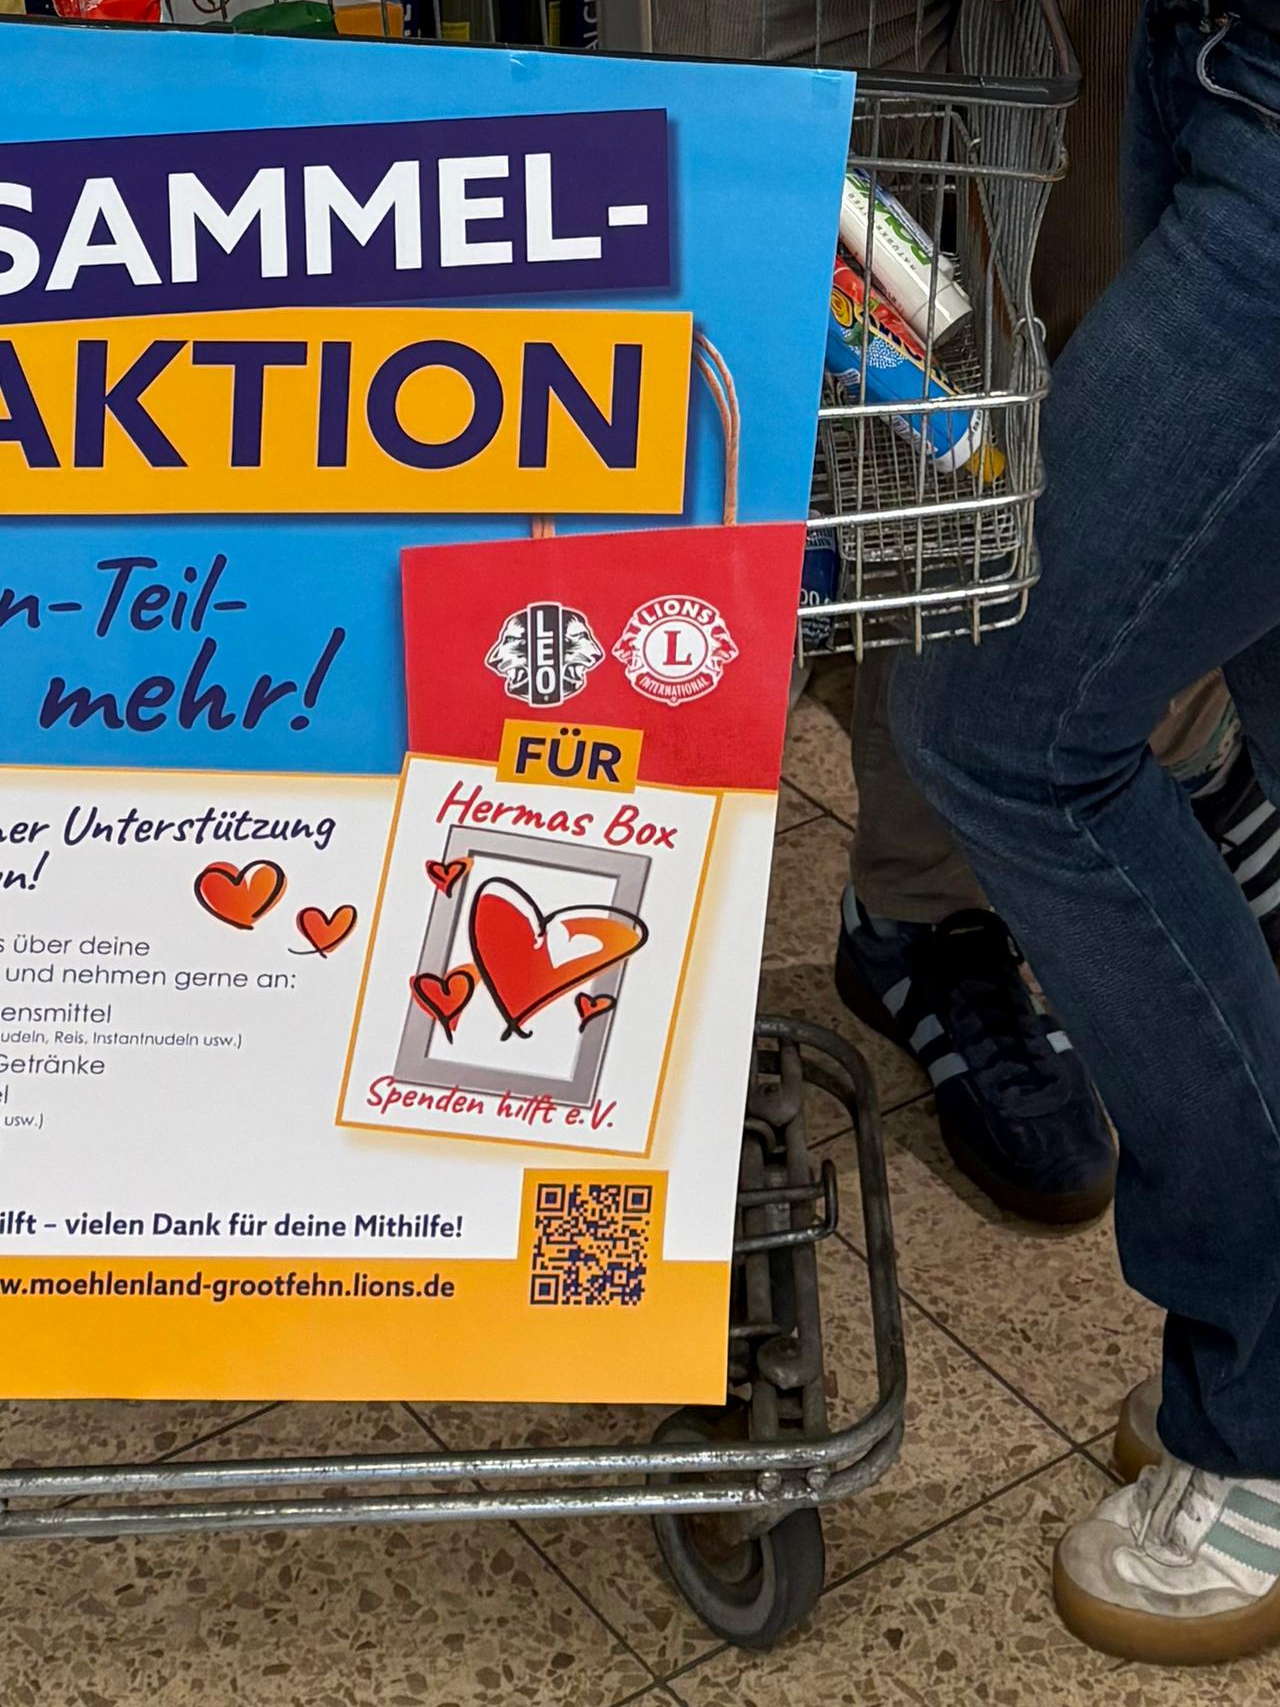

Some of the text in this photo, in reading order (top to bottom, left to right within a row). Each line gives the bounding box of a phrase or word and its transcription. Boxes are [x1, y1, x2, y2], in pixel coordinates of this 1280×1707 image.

[640, 600, 713, 625] LIONS
[536, 610, 556, 694] LEO
[662, 630, 692, 666] L
[40, 626, 346, 733] mehr!
[639, 676, 709, 699] INTERNATIONAL
[515, 727, 621, 783] FÜR
[63, 805, 337, 850] Unterstützung
[436, 780, 683, 850] Hermas Box
[13, 934, 72, 957] über
[79, 935, 151, 957] deine
[5, 963, 54, 984] und
[61, 966, 167, 987] nehmen
[174, 969, 249, 991] gerne
[256, 970, 297, 989] an:
[54, 1031, 88, 1047] Reis,
[92, 1032, 199, 1047] Instantnudeln
[203, 1034, 243, 1049] usw.)
[367, 1075, 615, 1132] Spenden hilft e.V.
[4, 1113, 44, 1130] usw.)
[64, 1212, 145, 1237] vielen
[152, 1212, 221, 1237] Dank
[228, 1212, 268, 1238] für
[273, 1213, 346, 1238] deine
[353, 1214, 463, 1240] Mithilfe!
